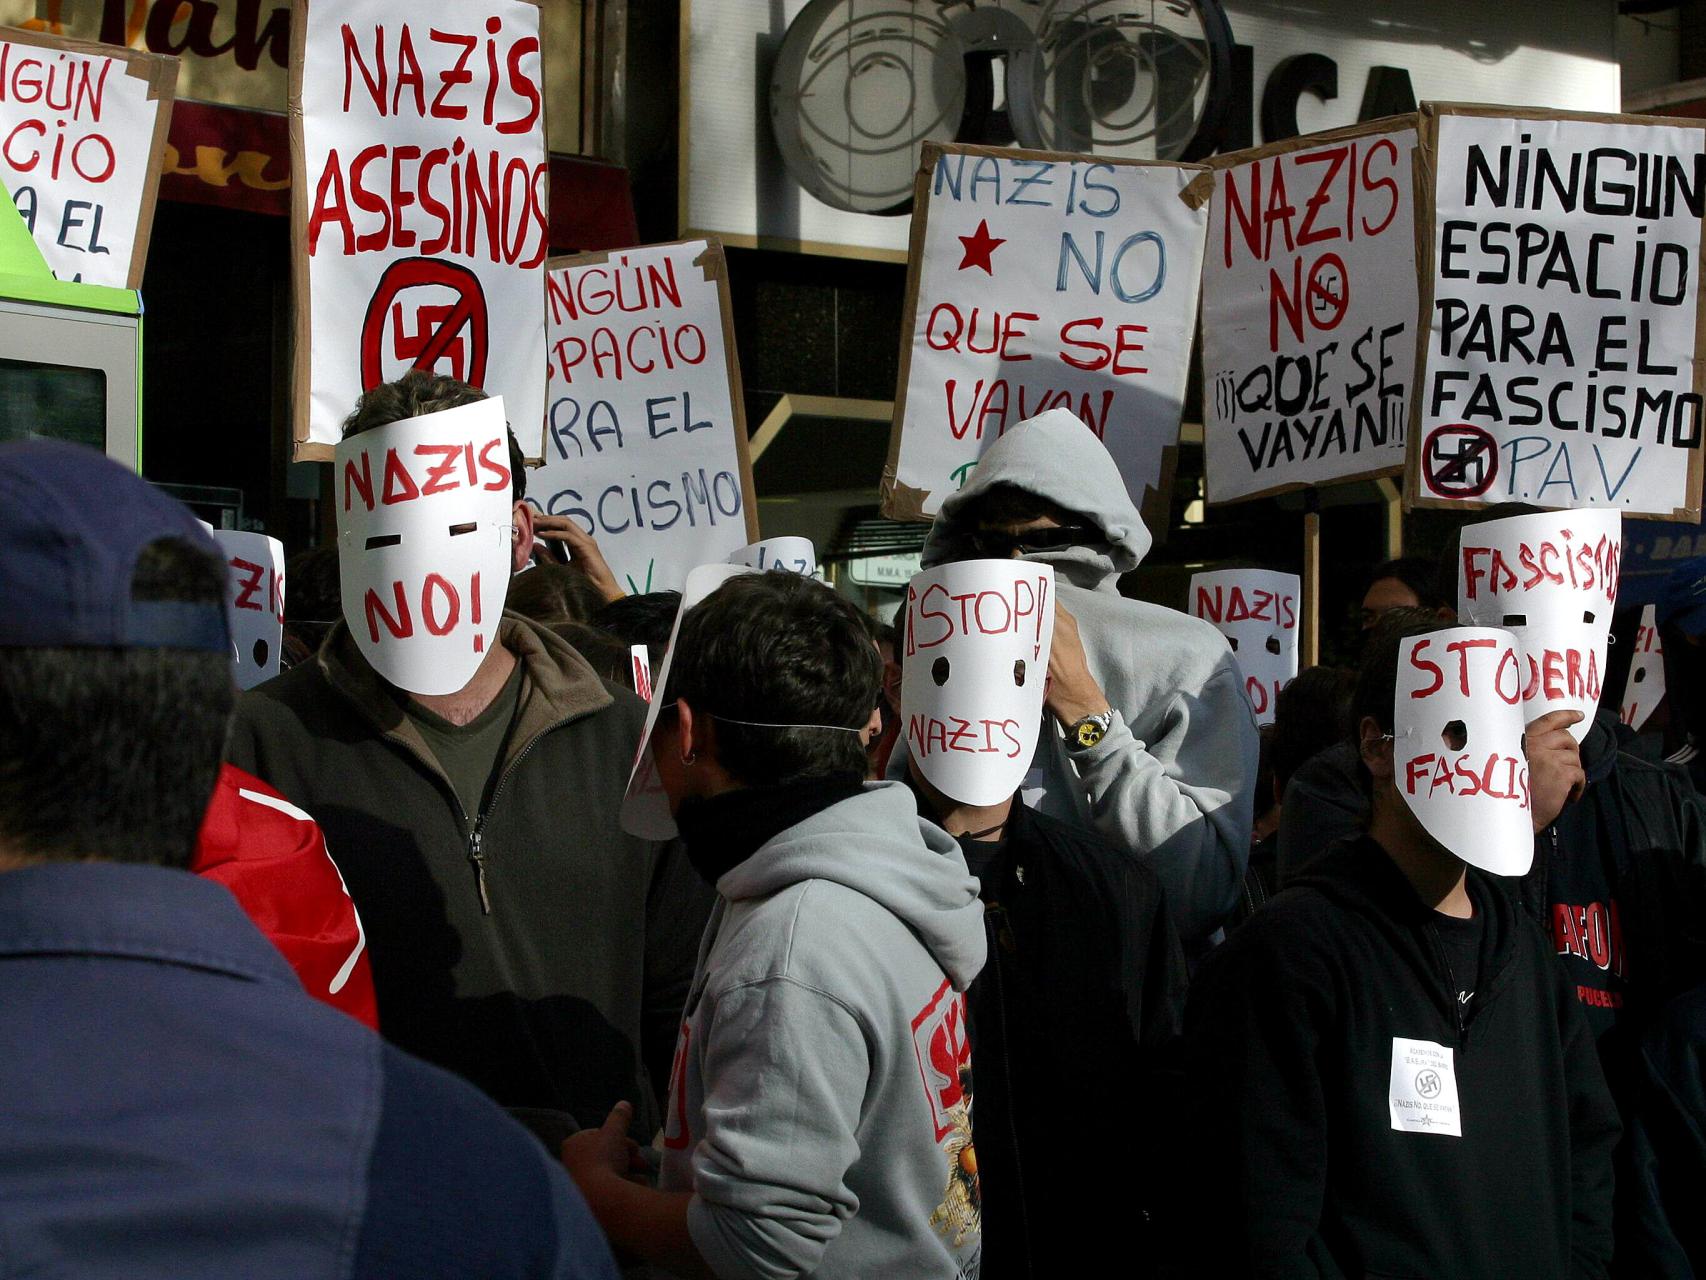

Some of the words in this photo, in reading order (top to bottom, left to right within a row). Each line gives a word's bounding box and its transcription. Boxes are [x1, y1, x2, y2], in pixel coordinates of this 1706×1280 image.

[342, 16, 540, 134] NAZIS
[308, 136, 549, 269] ASESINOS
[933, 153, 1122, 217] NAZIS
[1224, 138, 1399, 269] NAZIS
[1464, 133, 1706, 221] NINGUN
[57, 199, 110, 255] EL
[1440, 220, 1689, 306] ESPACIO
[1056, 229, 1168, 304] NO
[926, 302, 1041, 362] QUE
[1059, 316, 1149, 376] SE
[1345, 322, 1405, 406] SE
[1435, 298, 1576, 368] PARA
[1595, 316, 1678, 377] EL
[646, 391, 713, 440] EL
[1430, 370, 1704, 449] FASCISMO
[344, 438, 512, 512] NAZIS
[524, 468, 743, 536] SCISMO
[226, 556, 286, 625] ZIS
[364, 570, 484, 654] NO!
[906, 576, 1048, 662] ¡STOP!
[1197, 585, 1296, 630] NAZIS
[909, 713, 1022, 759] NAZIS
[1405, 752, 1530, 812] FASCIS
